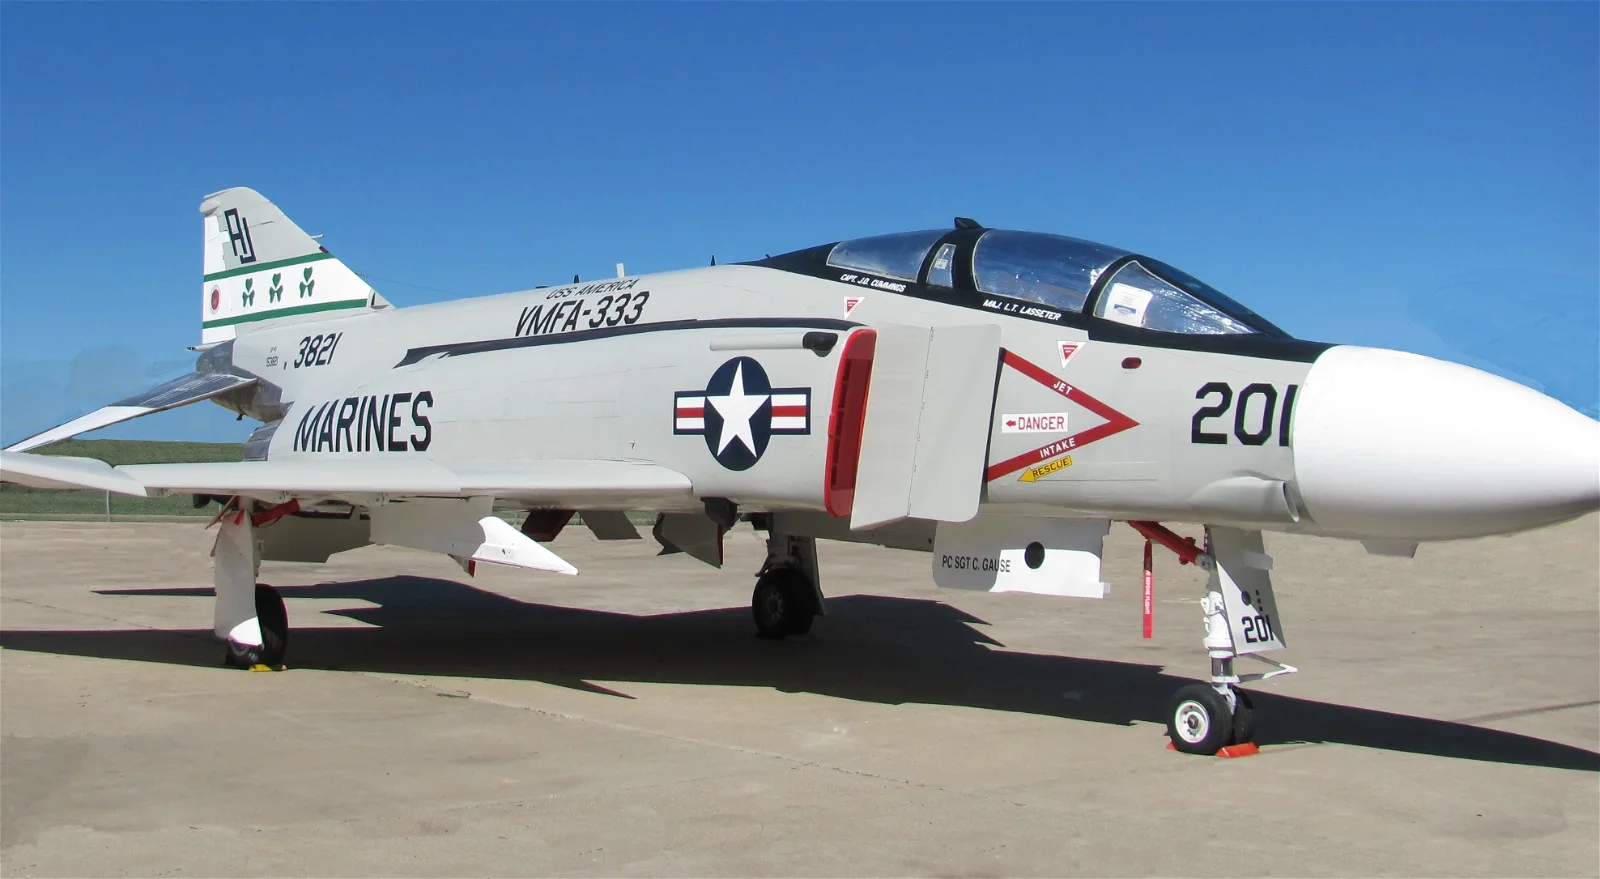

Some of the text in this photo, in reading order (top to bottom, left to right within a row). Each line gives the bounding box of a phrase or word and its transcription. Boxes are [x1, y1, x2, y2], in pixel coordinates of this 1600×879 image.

[224, 207, 257, 265] AJ
[546, 278, 641, 300] USS AMERICA
[840, 273, 859, 283] CAPT.
[870, 279, 907, 293] CUMMINGS
[515, 291, 650, 337] VMFA-333
[982, 299, 1062, 321] MAJ. L.T. LASSETER
[293, 332, 343, 369] 3821
[1053, 380, 1073, 395] JET
[293, 390, 434, 452] MARINES
[1018, 416, 1065, 430] DANGER
[1191, 382, 1298, 447] 201
[1039, 437, 1076, 459] INTAKE
[1032, 457, 1070, 478] RESCUE
[942, 555, 1011, 573] PC SGT C. GAUSE
[1241, 614, 1274, 643] 201
